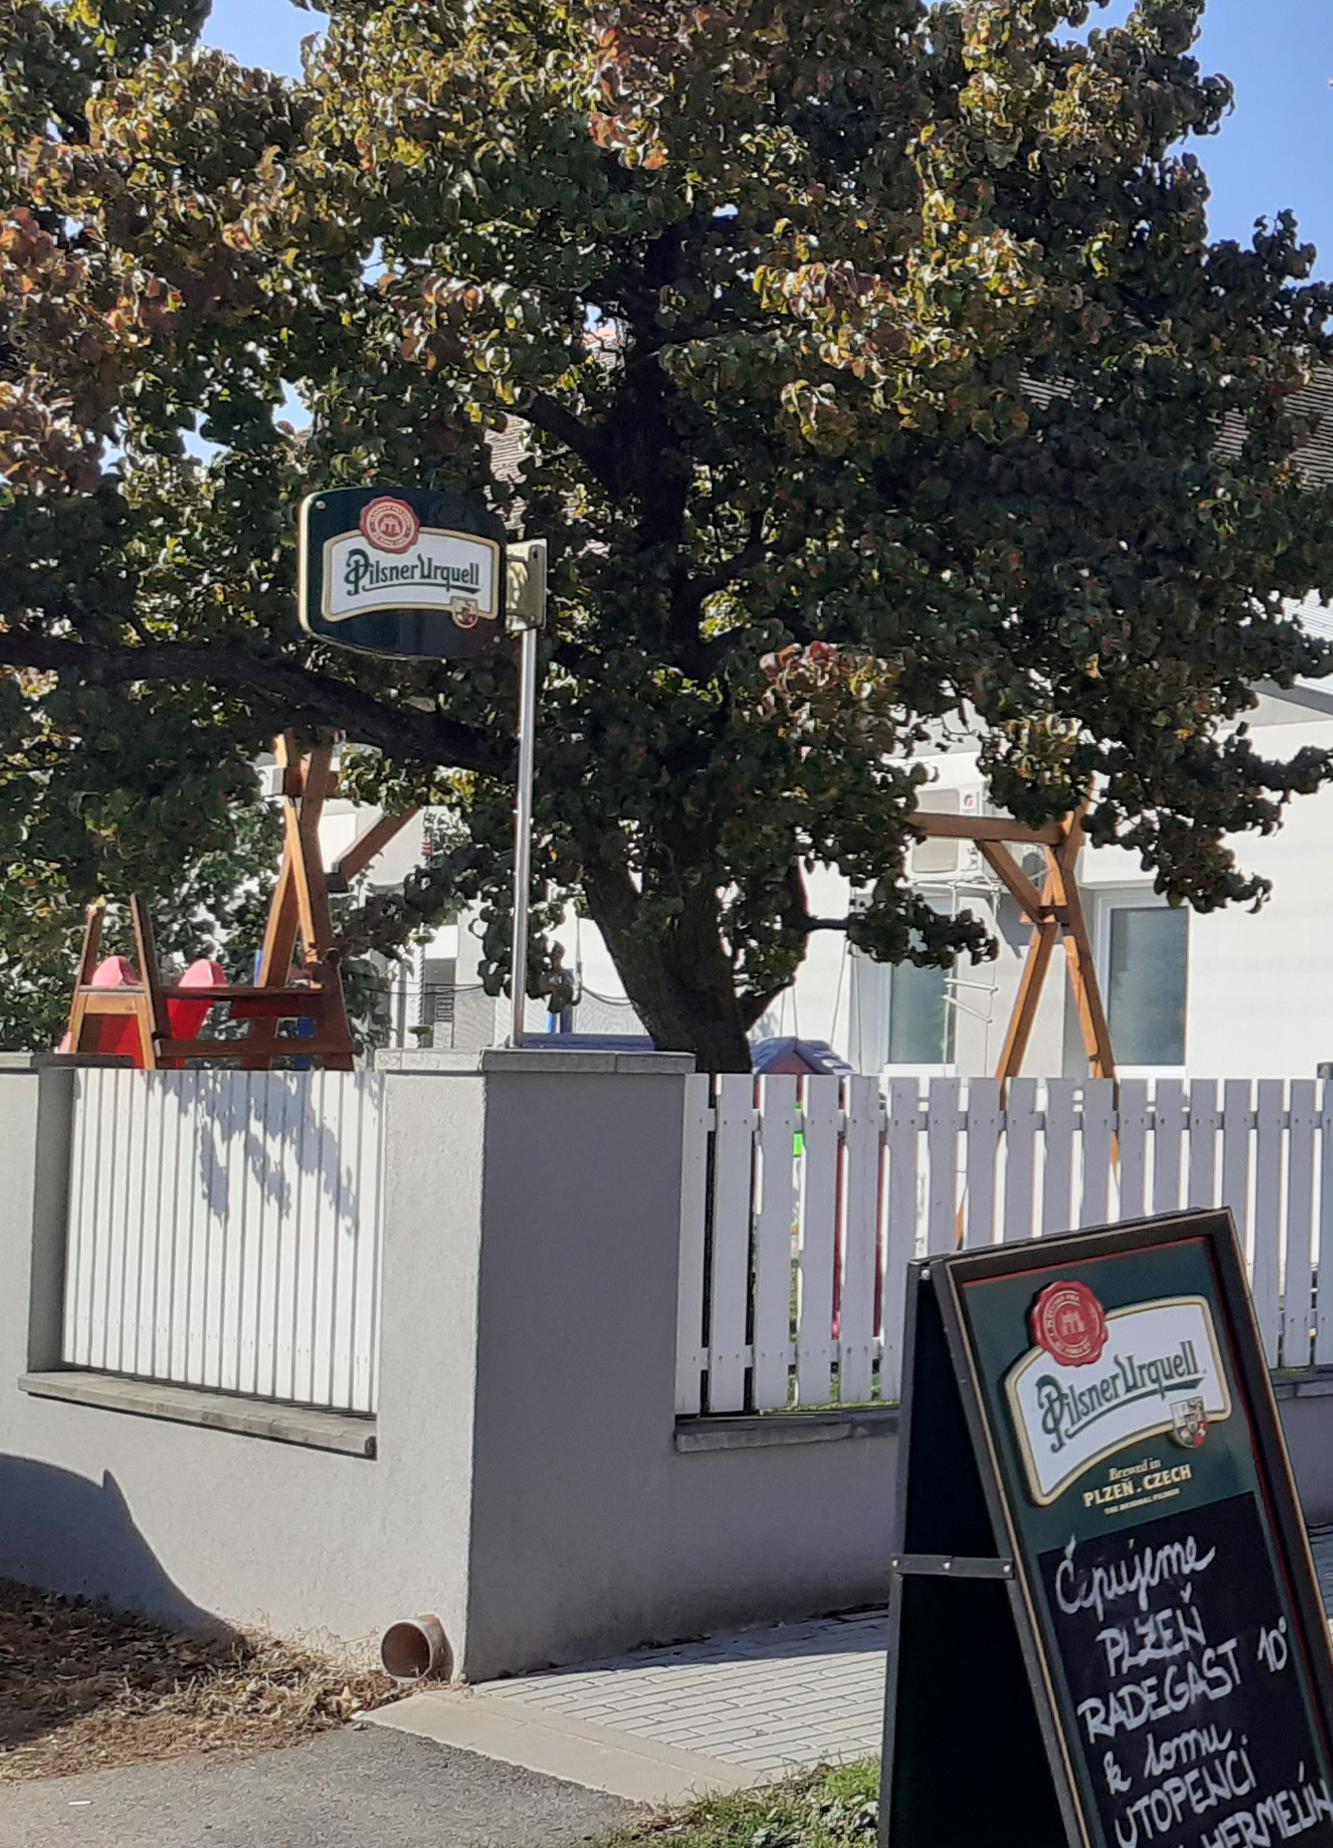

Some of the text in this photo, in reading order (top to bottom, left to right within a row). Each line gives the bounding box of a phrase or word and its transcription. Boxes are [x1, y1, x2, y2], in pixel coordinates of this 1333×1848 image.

[344, 549, 480, 595] Pilsner Urquell
[1035, 1340, 1199, 1453] Pilsner Urquell
[1109, 1458, 1148, 1481] Brewed
[1143, 1464, 1192, 1491] CZECH
[1056, 1534, 1216, 1622] Čepujeme
[1096, 1582, 1207, 1678] PLZEŇ
[1077, 1638, 1242, 1744] RADEGAST
